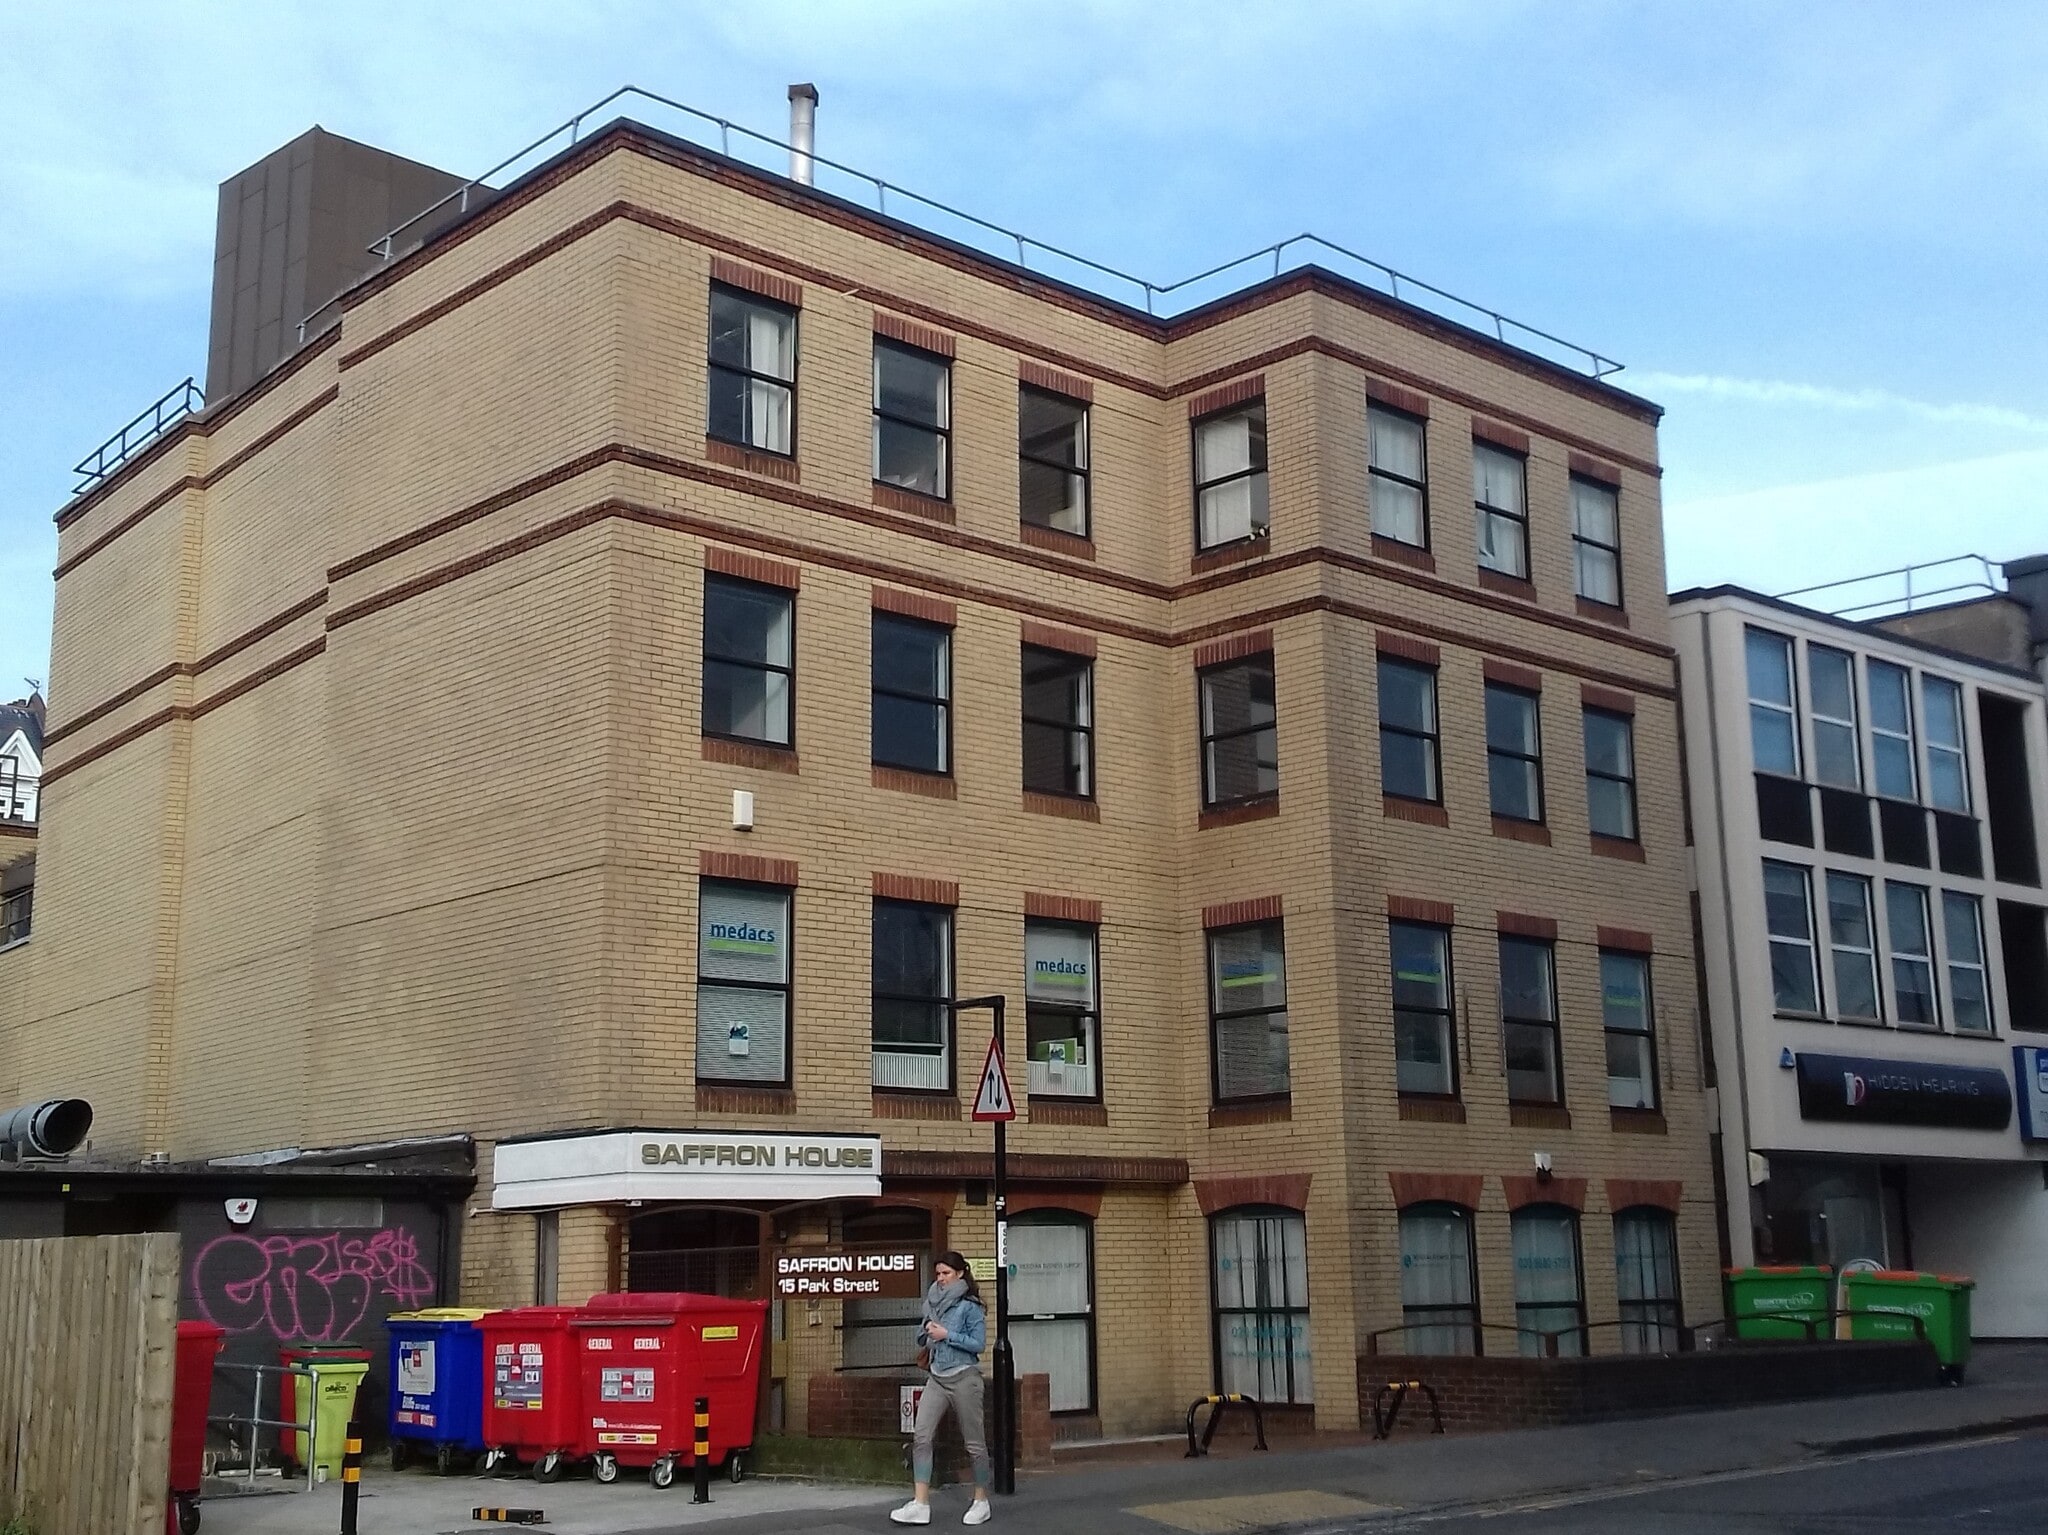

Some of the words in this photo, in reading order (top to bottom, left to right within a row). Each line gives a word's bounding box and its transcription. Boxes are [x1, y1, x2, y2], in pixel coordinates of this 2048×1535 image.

[710, 922, 775, 942] medacs
[1035, 958, 1087, 975] medacs
[641, 1143, 776, 1167] SAFFRON
[785, 1146, 873, 1168] HOUSE
[778, 1256, 853, 1274] SAFFRON
[857, 1254, 915, 1272] HOUSE
[778, 1279, 796, 1293] 15
[798, 1278, 830, 1294] Park
[833, 1278, 880, 1293] Street
